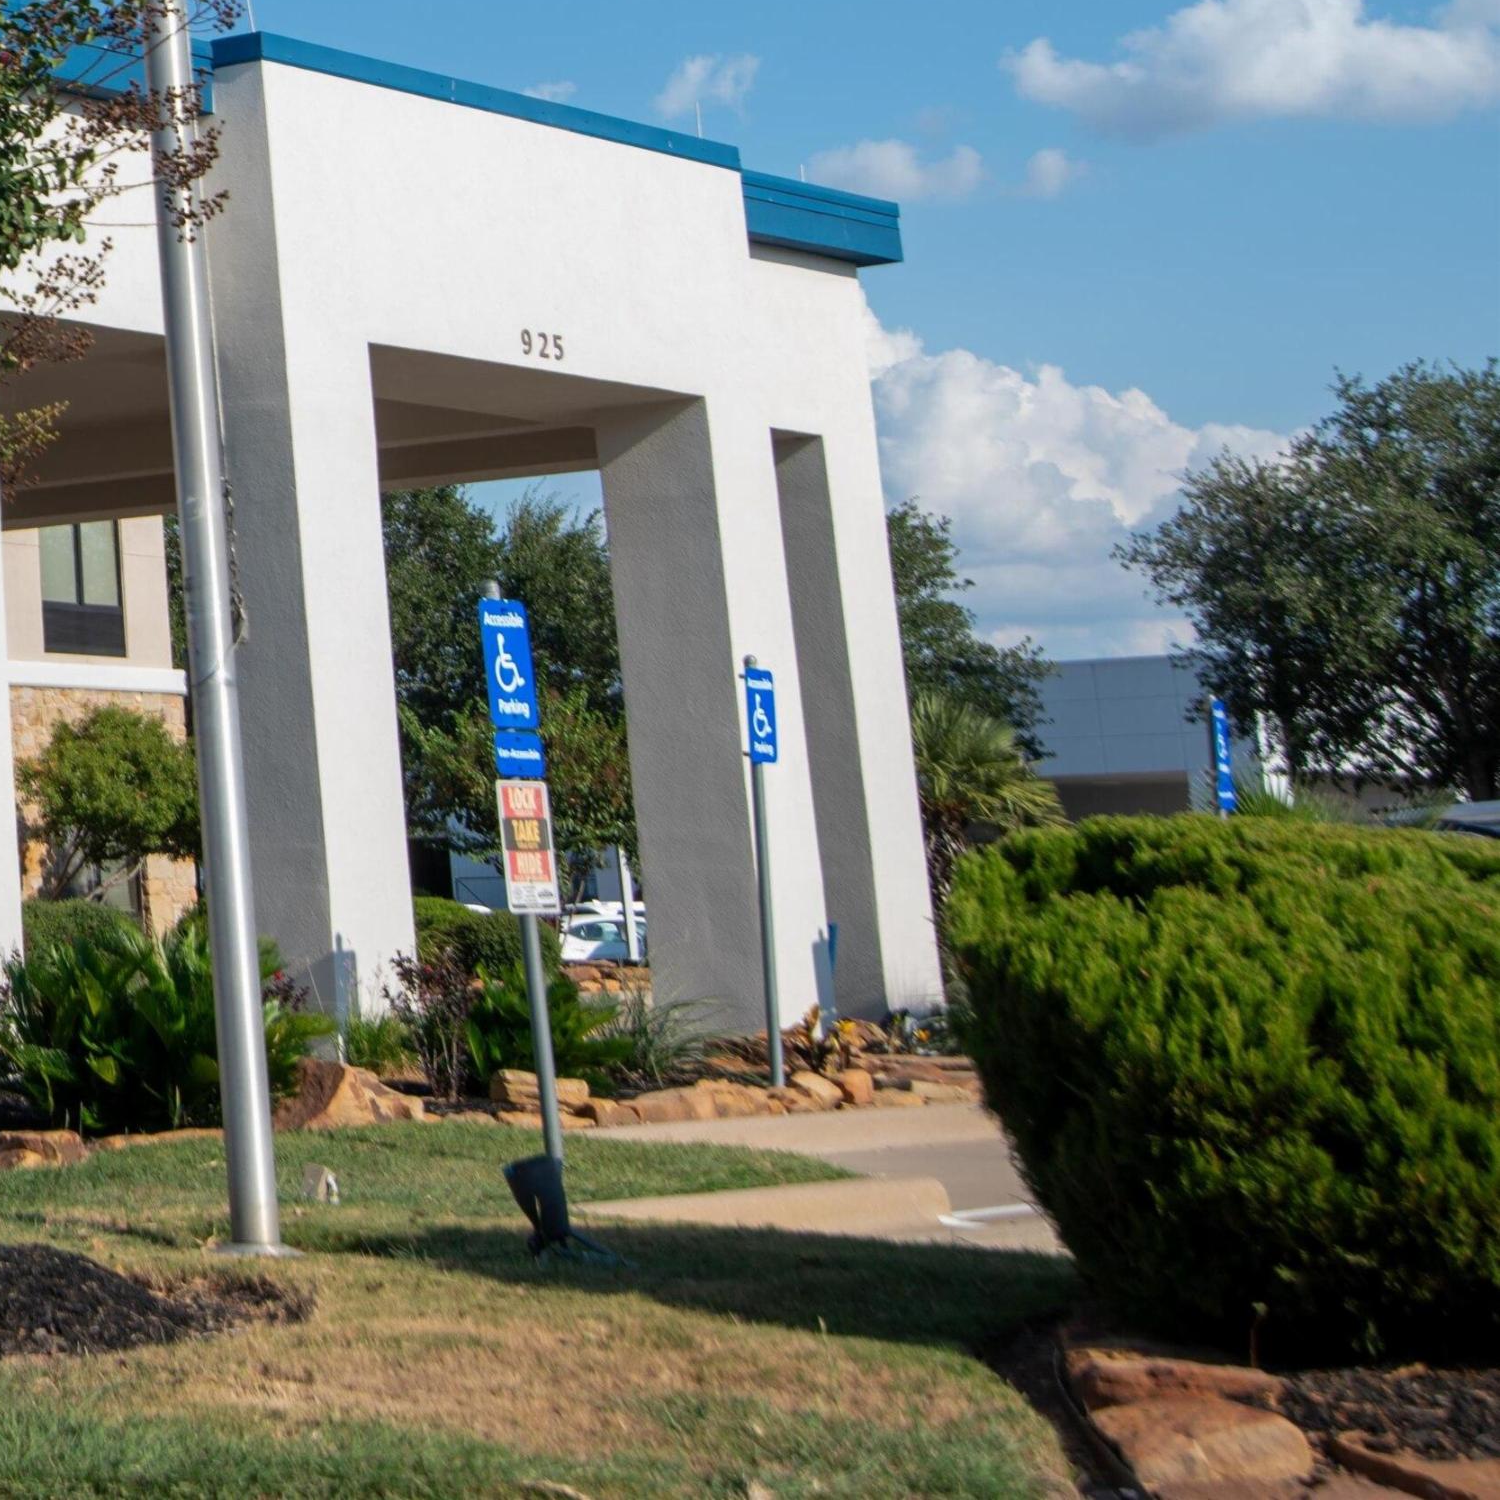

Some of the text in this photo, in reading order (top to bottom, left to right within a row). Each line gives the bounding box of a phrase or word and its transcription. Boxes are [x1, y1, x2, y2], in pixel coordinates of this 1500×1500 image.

[520, 328, 565, 361] 925
[483, 611, 524, 629] Accessible
[512, 819, 540, 843] TAKE
